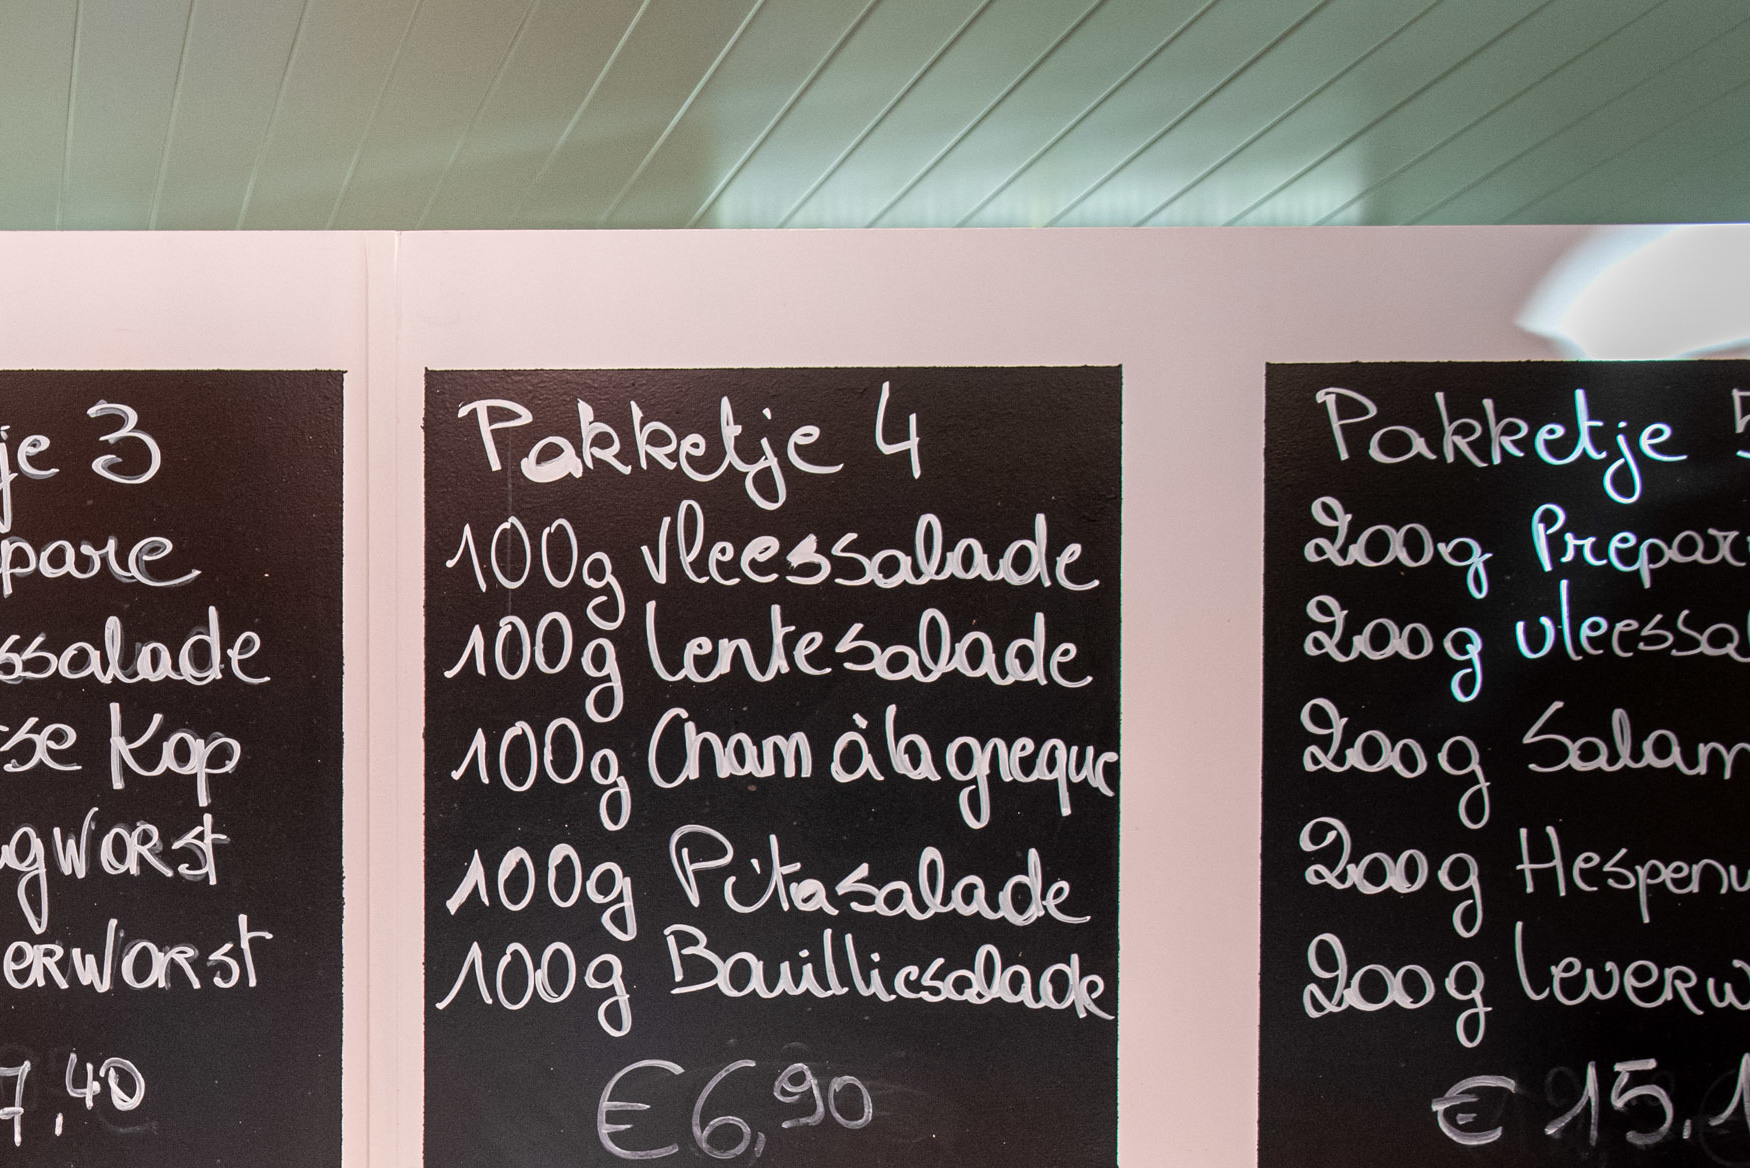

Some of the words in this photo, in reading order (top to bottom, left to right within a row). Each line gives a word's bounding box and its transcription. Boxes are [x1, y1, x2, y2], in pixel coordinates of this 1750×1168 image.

[87, 400, 162, 484] 3
[458, 396, 844, 510] Pakketje
[875, 380, 921, 479] 4
[1315, 387, 1688, 504] Pakketje
[446, 516, 625, 630] 100g
[1303, 496, 1493, 599] 200g
[1531, 503, 1750, 589] Prepar
[444, 612, 625, 723] 100g
[1303, 594, 1483, 702] 200g
[452, 717, 631, 831] 100g
[1300, 697, 1491, 830] 200g
[446, 843, 637, 941] 100g
[1298, 816, 1484, 938] 200g
[437, 941, 631, 1038] 100g
[1302, 933, 1493, 1049] 200g
[1431, 1075, 1516, 1146] €
